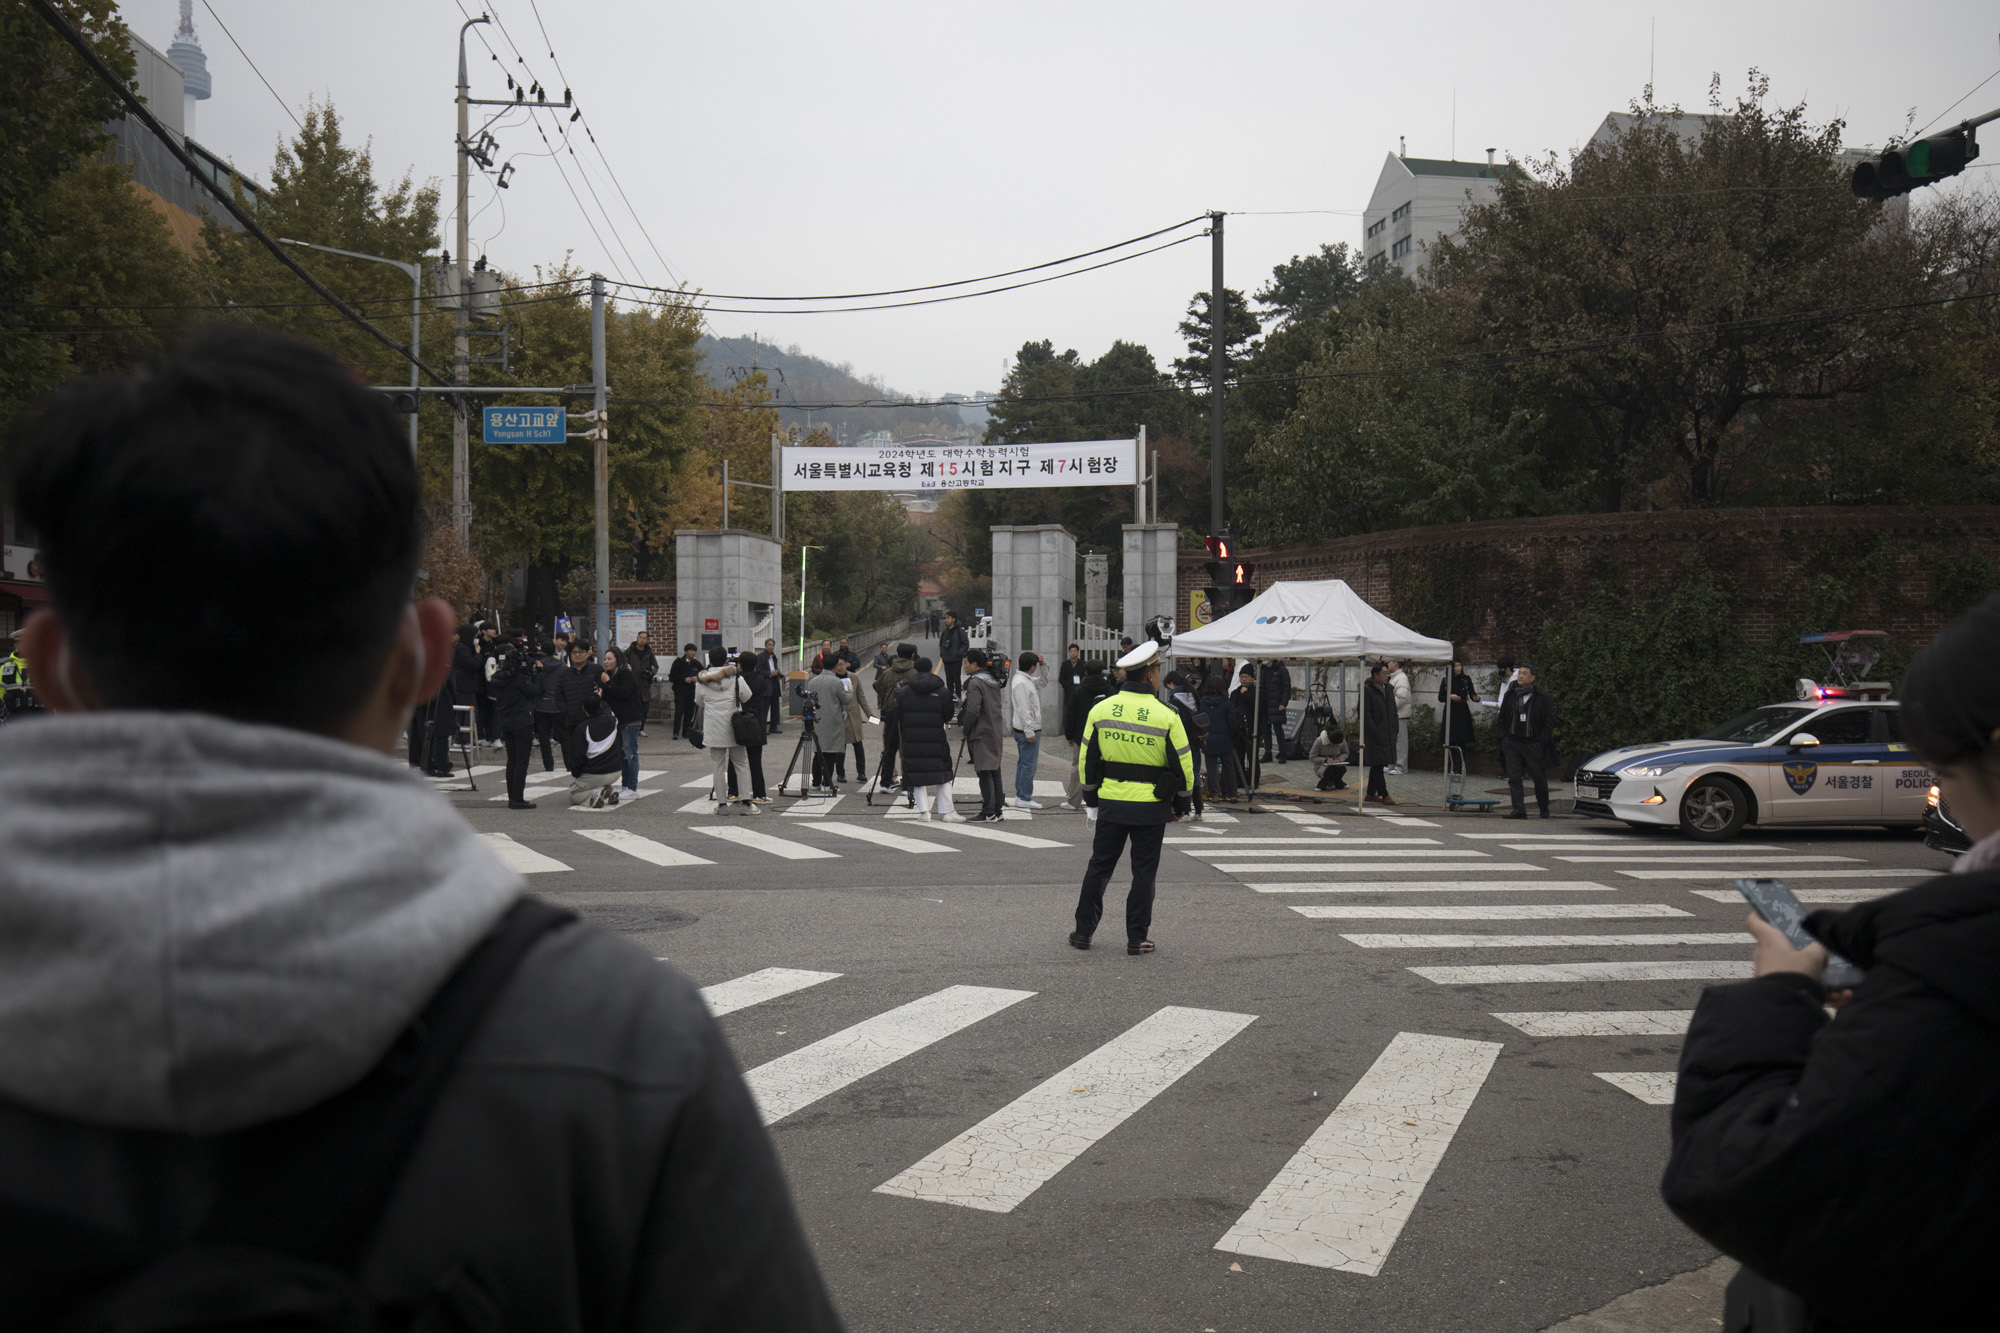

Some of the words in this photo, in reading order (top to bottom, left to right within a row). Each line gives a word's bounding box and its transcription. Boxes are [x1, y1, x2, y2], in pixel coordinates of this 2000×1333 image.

[490, 412, 559, 428] 용산고교앞
[493, 429, 524, 439] Yongsan
[526, 430, 532, 438] H
[533, 429, 552, 438] Sch'l
[878, 449, 937, 460] 2024학년도
[942, 446, 1030, 459] 대학수학능력시험
[793, 461, 912, 479] 서울특별시교육청
[940, 479, 985, 488] 용산고등학교
[1280, 614, 1311, 624] YTN
[1104, 731, 1156, 746] POLICE
[1902, 769, 1932, 778] SEOUL
[1825, 775, 1873, 789] 서울경찰
